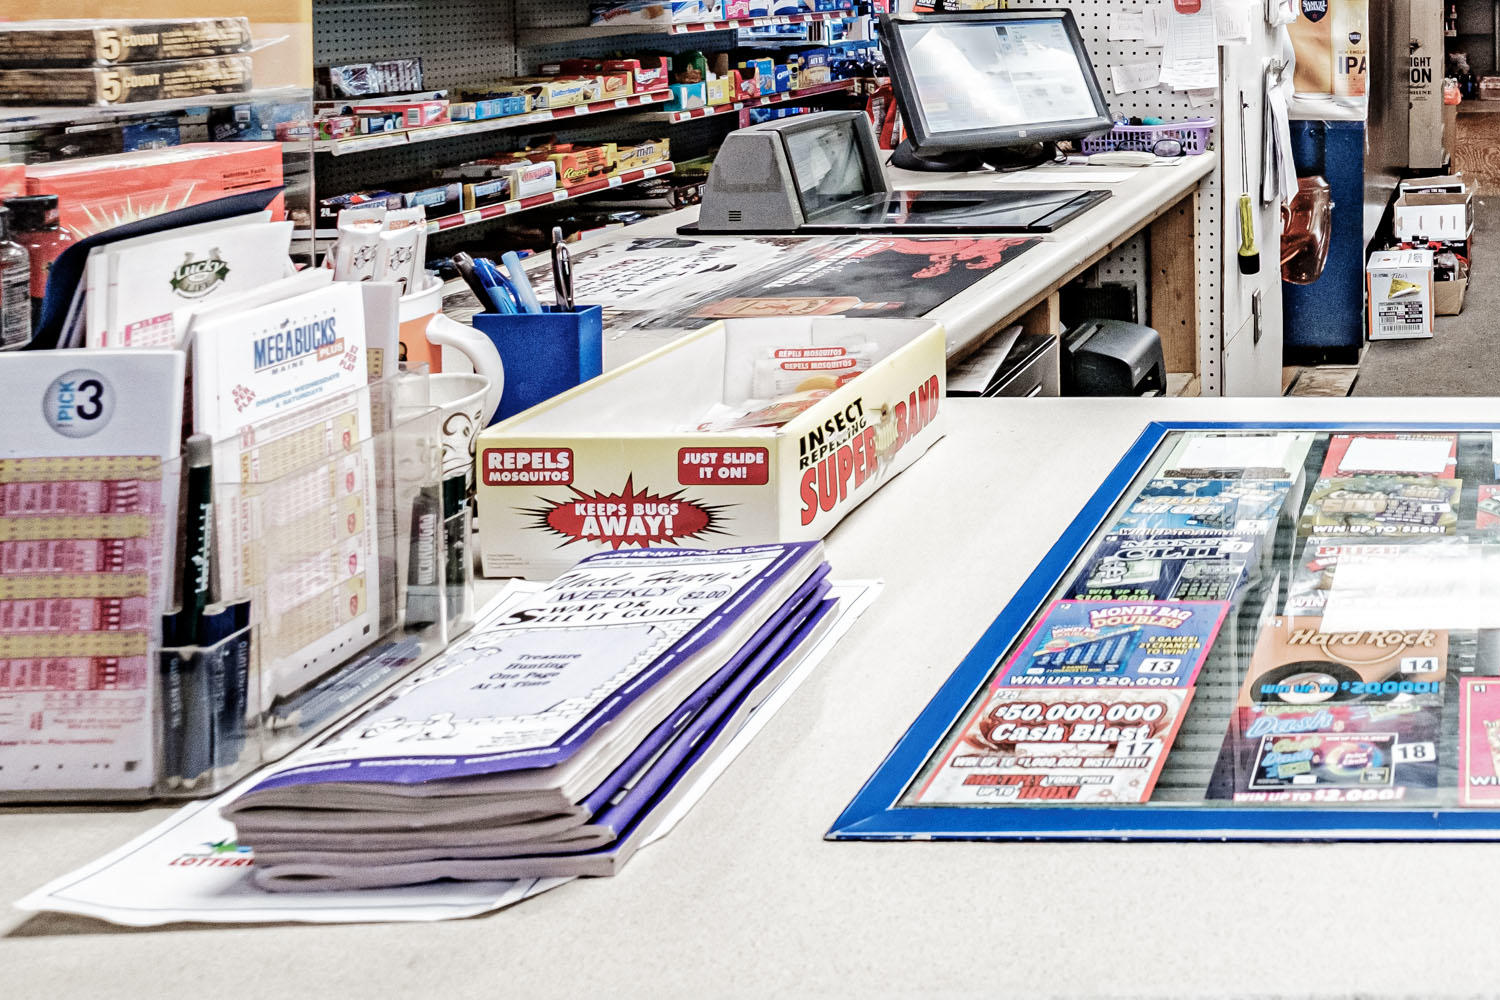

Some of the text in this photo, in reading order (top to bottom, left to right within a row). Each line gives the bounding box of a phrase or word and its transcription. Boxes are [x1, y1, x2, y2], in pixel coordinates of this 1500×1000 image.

[1303, 0, 1327, 8] SAMUEL
[101, 31, 121, 60] 5
[122, 33, 159, 48] COUNT
[1338, 56, 1366, 75] IPA
[102, 72, 121, 101] 5
[123, 73, 160, 88] COUNT
[175, 258, 225, 279] Lucky
[253, 317, 336, 370] MEGABUCKS
[318, 344, 344, 361] PLUS
[778, 349, 842, 358] REPELS MOSQUITOS
[784, 360, 852, 370] REPELS MOSQUITOS
[57, 379, 104, 421] PICK 3
[800, 397, 864, 457] INSECT
[800, 375, 940, 526] SUPER BAND
[488, 452, 570, 469] REPELS
[683, 452, 764, 464] JUST SLIDE
[488, 470, 570, 482] MOSQUITOS
[698, 467, 747, 479] IT ON!
[575, 503, 679, 516] KEEPS BUGS
[580, 516, 674, 536] AWAY!
[556, 586, 675, 602] WEEKLY
[682, 590, 727, 600] $2.00
[614, 601, 652, 609] OR
[1090, 605, 1193, 621] MONEY BAG
[1092, 616, 1184, 629] DOUBLER
[517, 652, 583, 661] Treasure
[504, 660, 570, 672] Hunting
[1149, 660, 1174, 672] 13
[1410, 659, 1434, 671] 14
[489, 670, 561, 682] One Page
[1010, 675, 1180, 687] WIN UP TO $20,000!
[995, 702, 1164, 723] $50,000,000
[991, 723, 1152, 742] Cash Blast
[1399, 745, 1427, 761] 18
